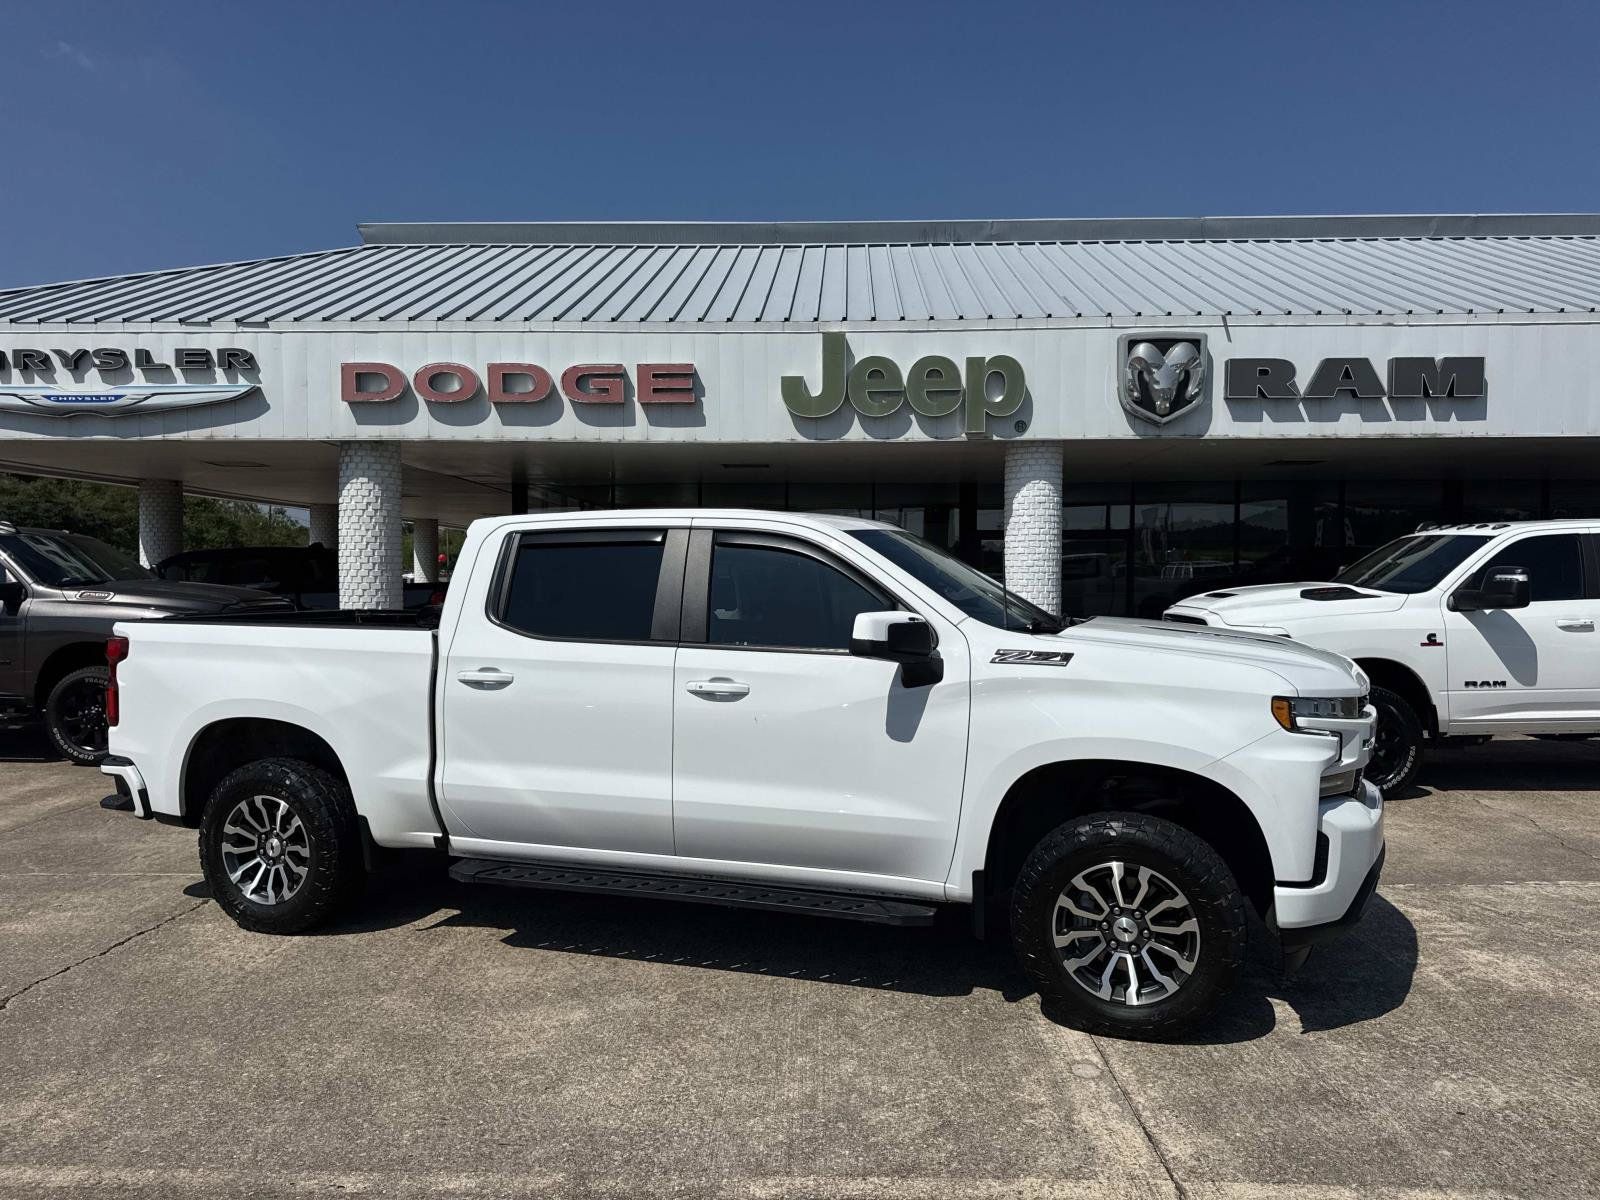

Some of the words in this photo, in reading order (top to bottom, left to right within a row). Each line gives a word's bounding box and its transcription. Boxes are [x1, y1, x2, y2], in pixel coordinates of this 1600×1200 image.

[0, 348, 254, 370] RYSLER
[1224, 357, 1485, 401] RAM
[341, 362, 695, 404] DODGE
[781, 332, 1026, 433] Jeep
[1464, 680, 1507, 688] RAM
